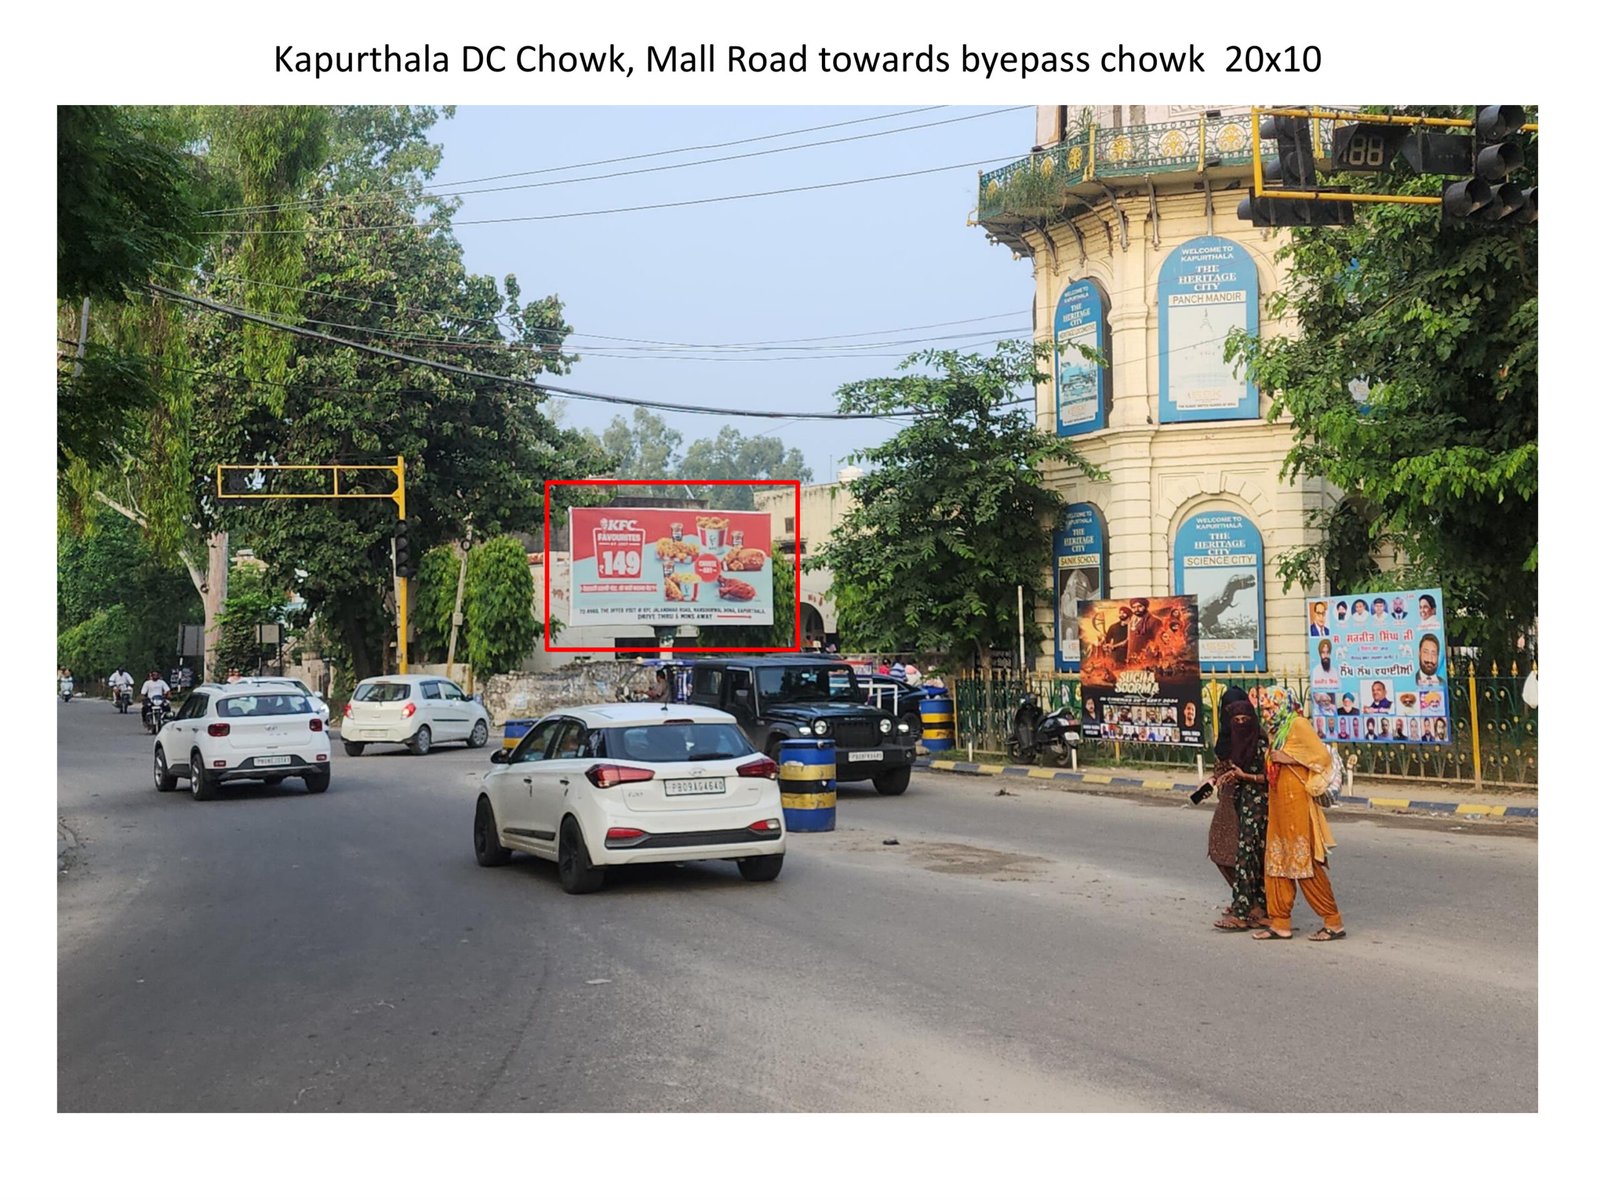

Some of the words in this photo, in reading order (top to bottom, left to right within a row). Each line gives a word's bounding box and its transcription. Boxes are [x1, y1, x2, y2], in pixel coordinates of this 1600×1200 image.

[1182, 246, 1221, 255] WELCOME
[1181, 253, 1234, 262] KAPURTHALA
[1178, 272, 1237, 284] HERITAGE
[1194, 282, 1220, 290] CITY
[1173, 294, 1204, 304] PANCH
[1206, 292, 1241, 302] MANDIR
[1071, 303, 1082, 312] THE
[1063, 308, 1090, 322] HERITAGE
[1070, 318, 1082, 326] CITY
[608, 520, 638, 530] KFC
[1072, 528, 1085, 536] THE
[1210, 532, 1230, 540] THE
[1064, 536, 1094, 546] HERITAGE
[1194, 540, 1246, 549] HERITAGE
[1186, 556, 1229, 566] SCIENCE
[1231, 556, 1253, 564] CITY
[1404, 629, 1413, 641] ਜੀ
[1119, 671, 1155, 683] SUCHA
[1114, 682, 1160, 694] SOORMA
